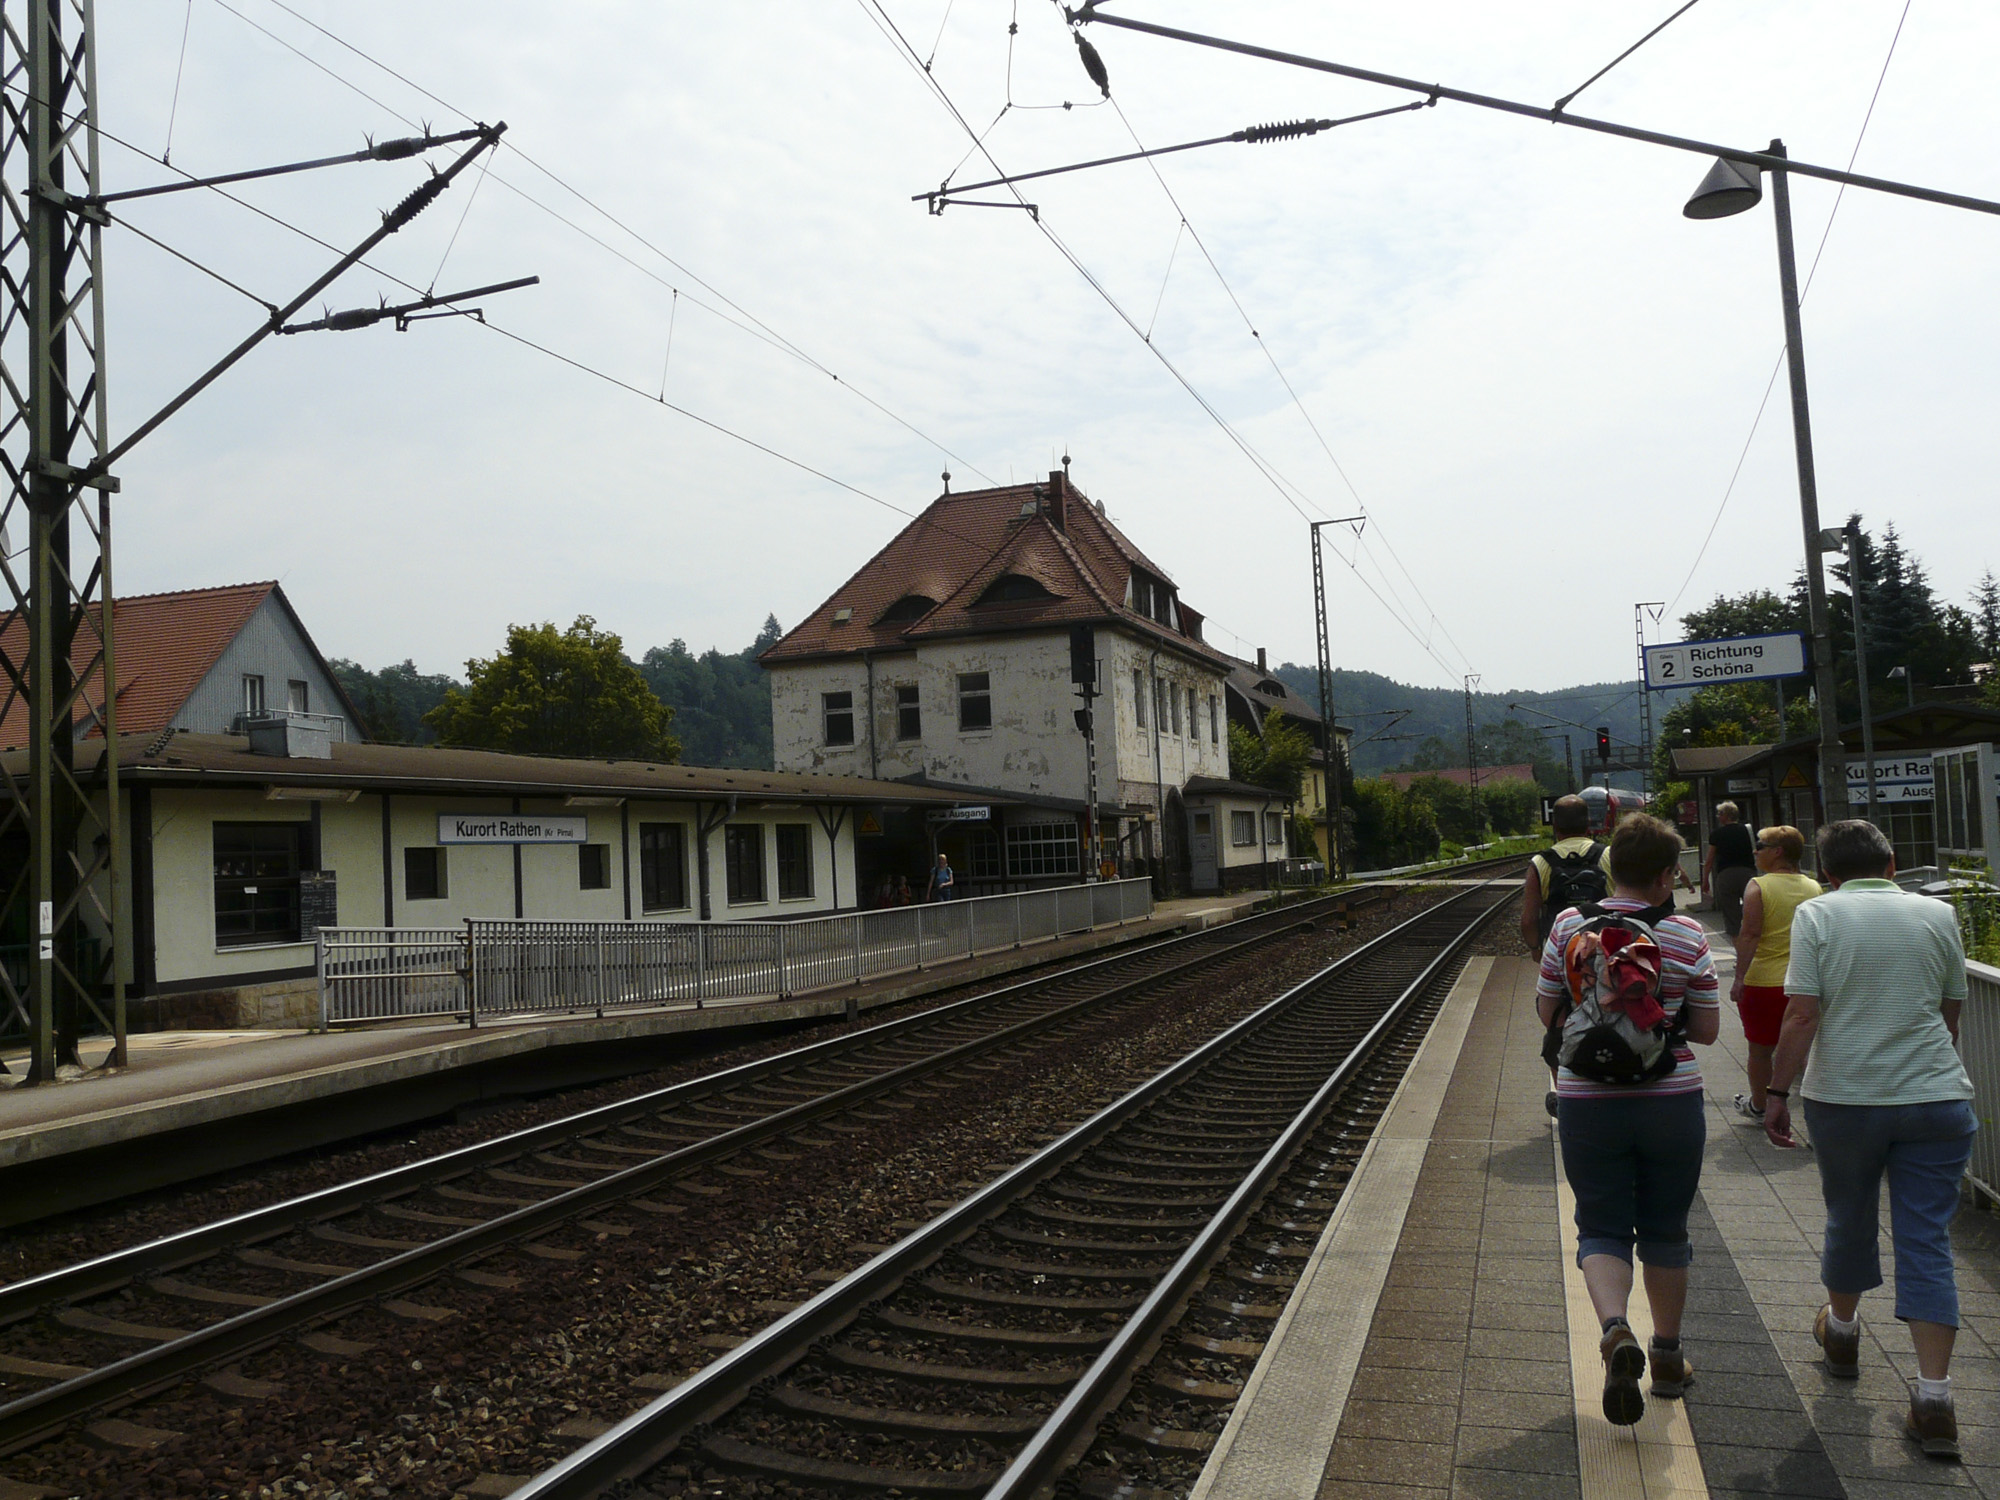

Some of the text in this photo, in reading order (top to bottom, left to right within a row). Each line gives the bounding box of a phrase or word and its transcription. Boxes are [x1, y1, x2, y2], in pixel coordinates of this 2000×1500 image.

[1690, 645, 1763, 661] Richtung
[1662, 662, 1675, 678] 2
[1692, 662, 1754, 679] Schöna
[1846, 761, 1933, 779] Kuort Ra
[949, 810, 986, 819] Ausgang
[456, 821, 497, 837] Kurort
[500, 821, 541, 837] Rathen
